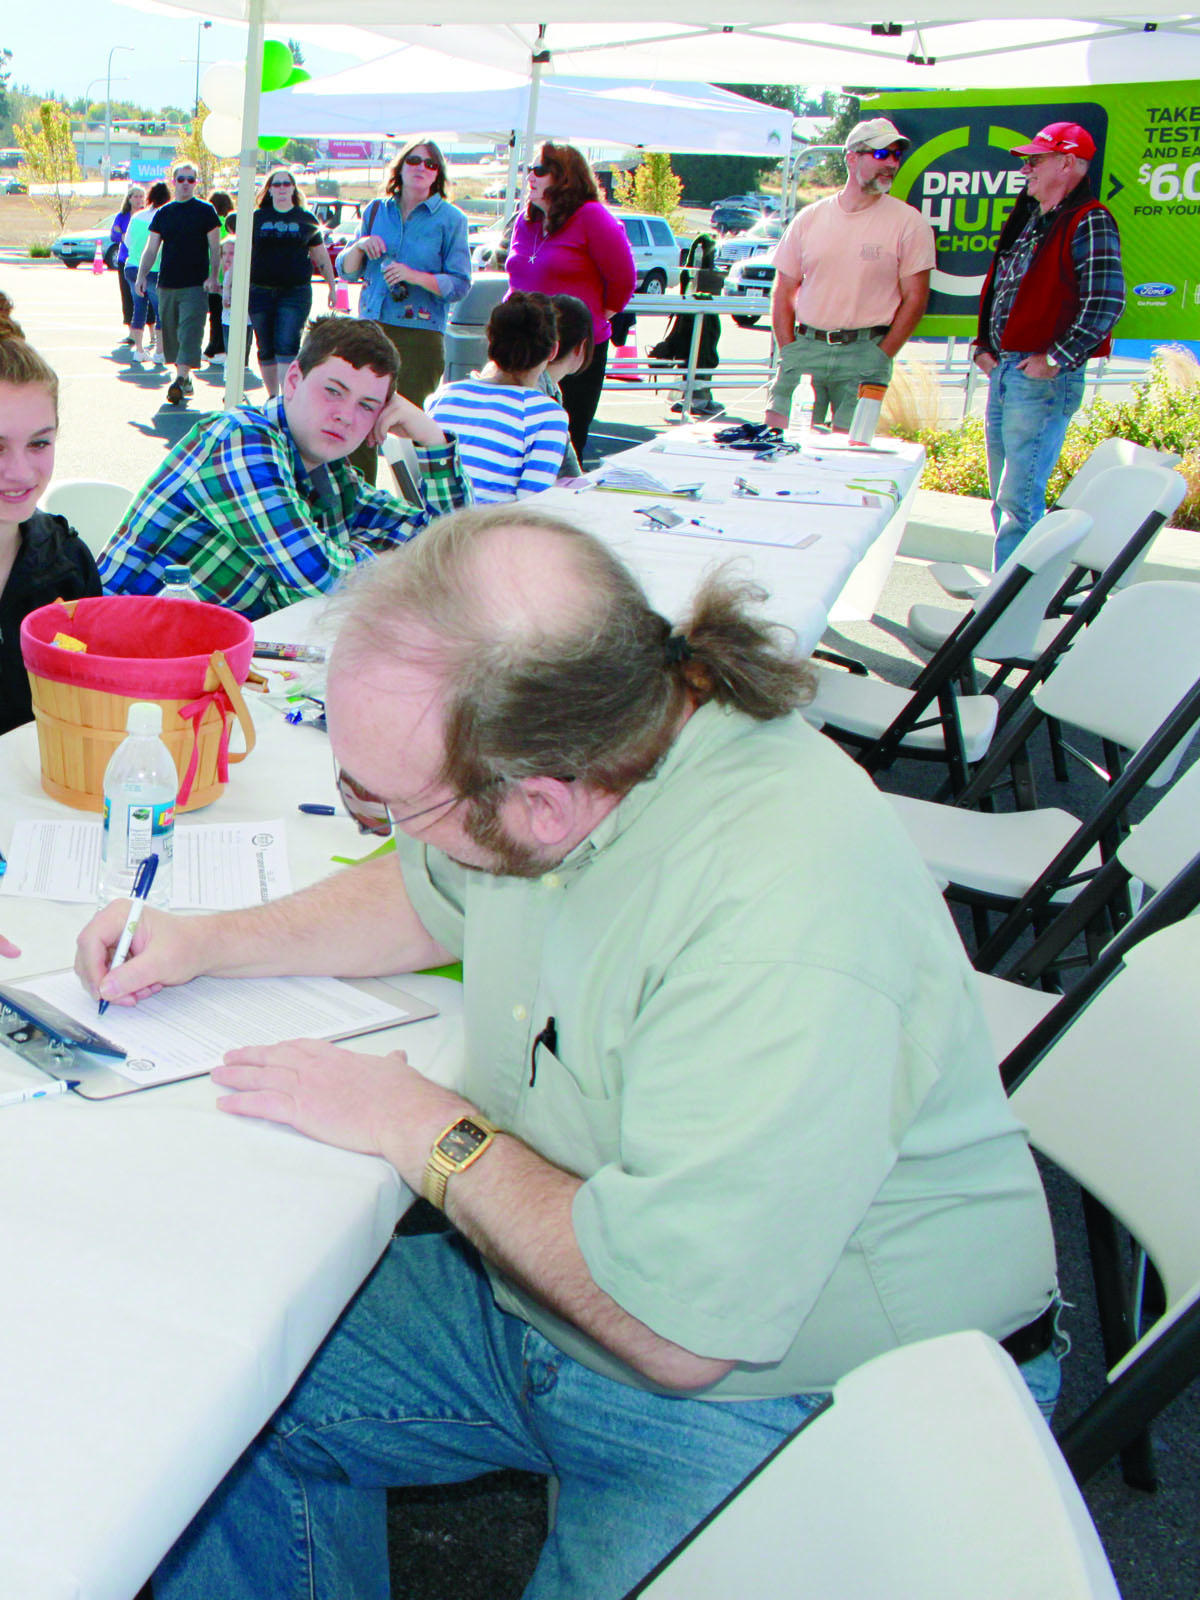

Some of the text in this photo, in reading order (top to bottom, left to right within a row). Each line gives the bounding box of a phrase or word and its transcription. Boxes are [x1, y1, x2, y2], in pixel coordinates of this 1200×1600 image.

[1146, 107, 1200, 123] TAKE
[1144, 126, 1200, 143] TEST
[1142, 147, 1178, 159] AND
[922, 170, 1026, 195] DRIVE
[1134, 206, 1163, 216] FOR
[1140, 286, 1167, 295] Ford
